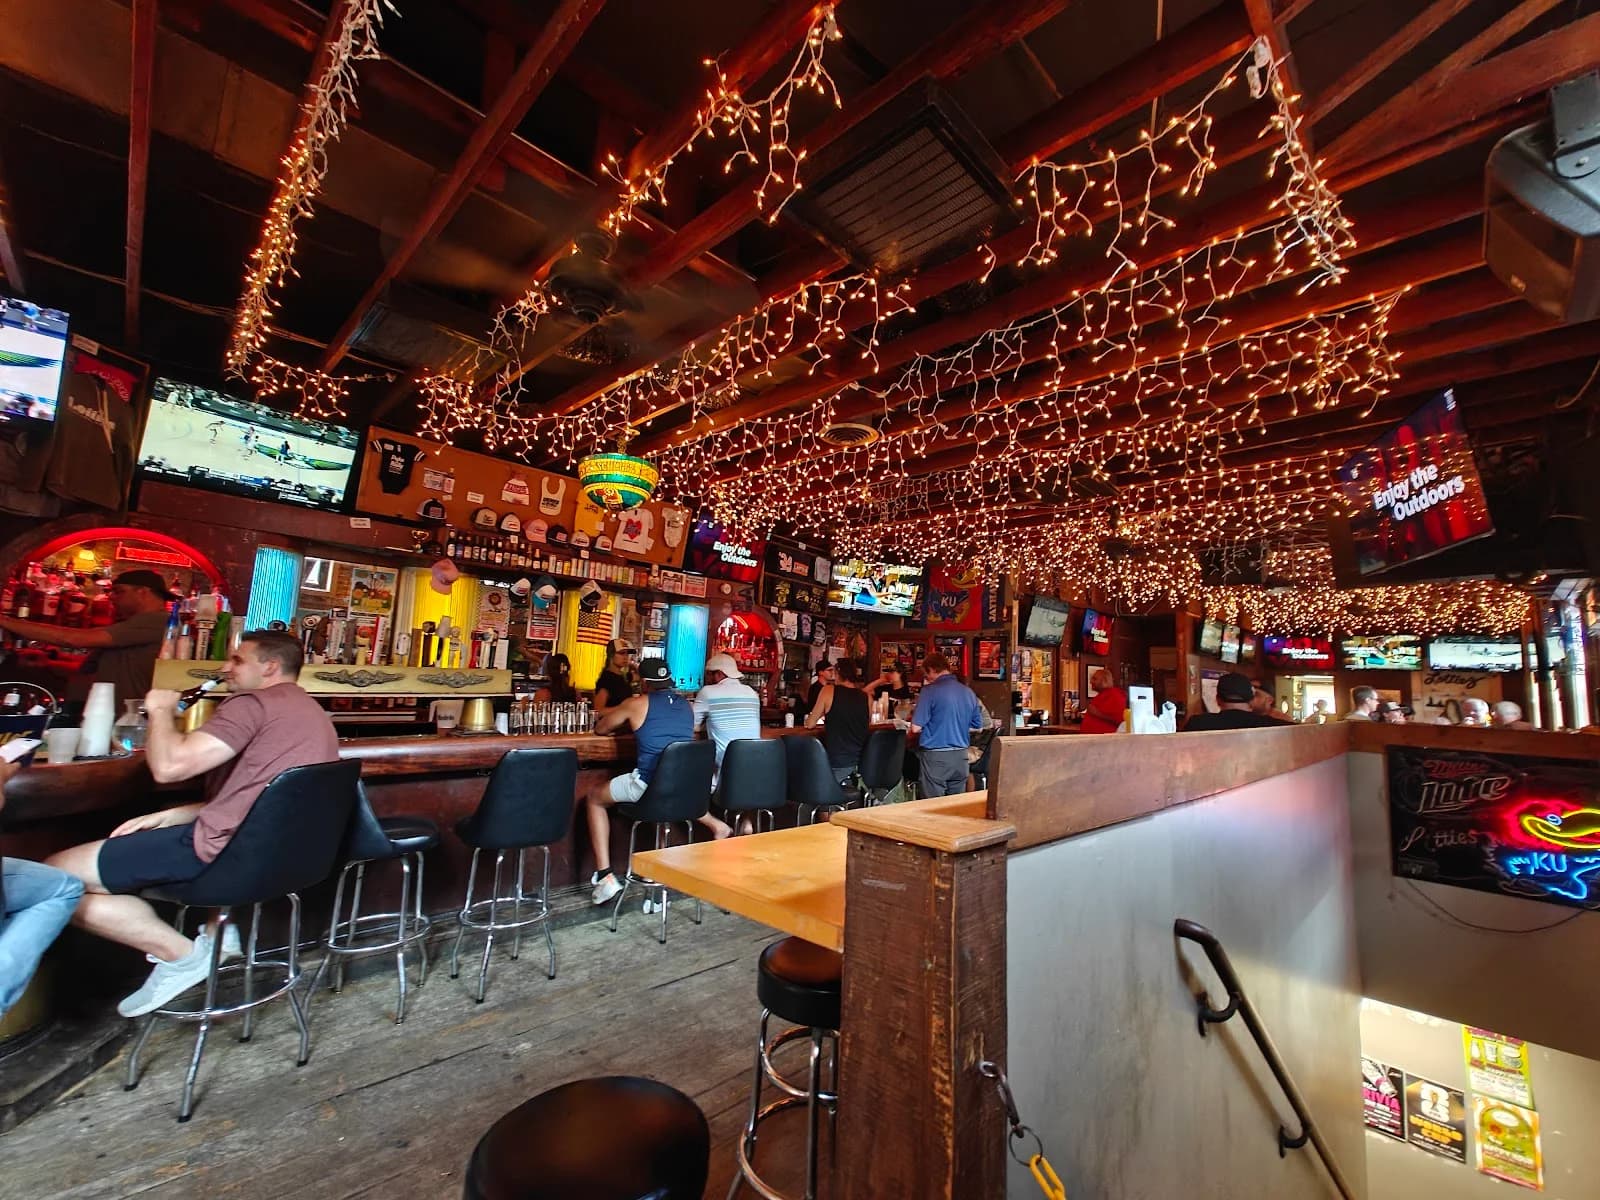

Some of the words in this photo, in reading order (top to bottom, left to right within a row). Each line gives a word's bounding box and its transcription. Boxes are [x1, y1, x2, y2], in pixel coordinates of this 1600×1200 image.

[1373, 477, 1410, 511] Enjoy
[1410, 462, 1438, 490] the
[1393, 474, 1466, 521] Outdoors
[713, 541, 739, 556] Enjoy
[737, 546, 751, 557] the
[721, 553, 758, 567] Outdoors
[941, 595, 957, 607] KU
[1533, 852, 1567, 873] KU
